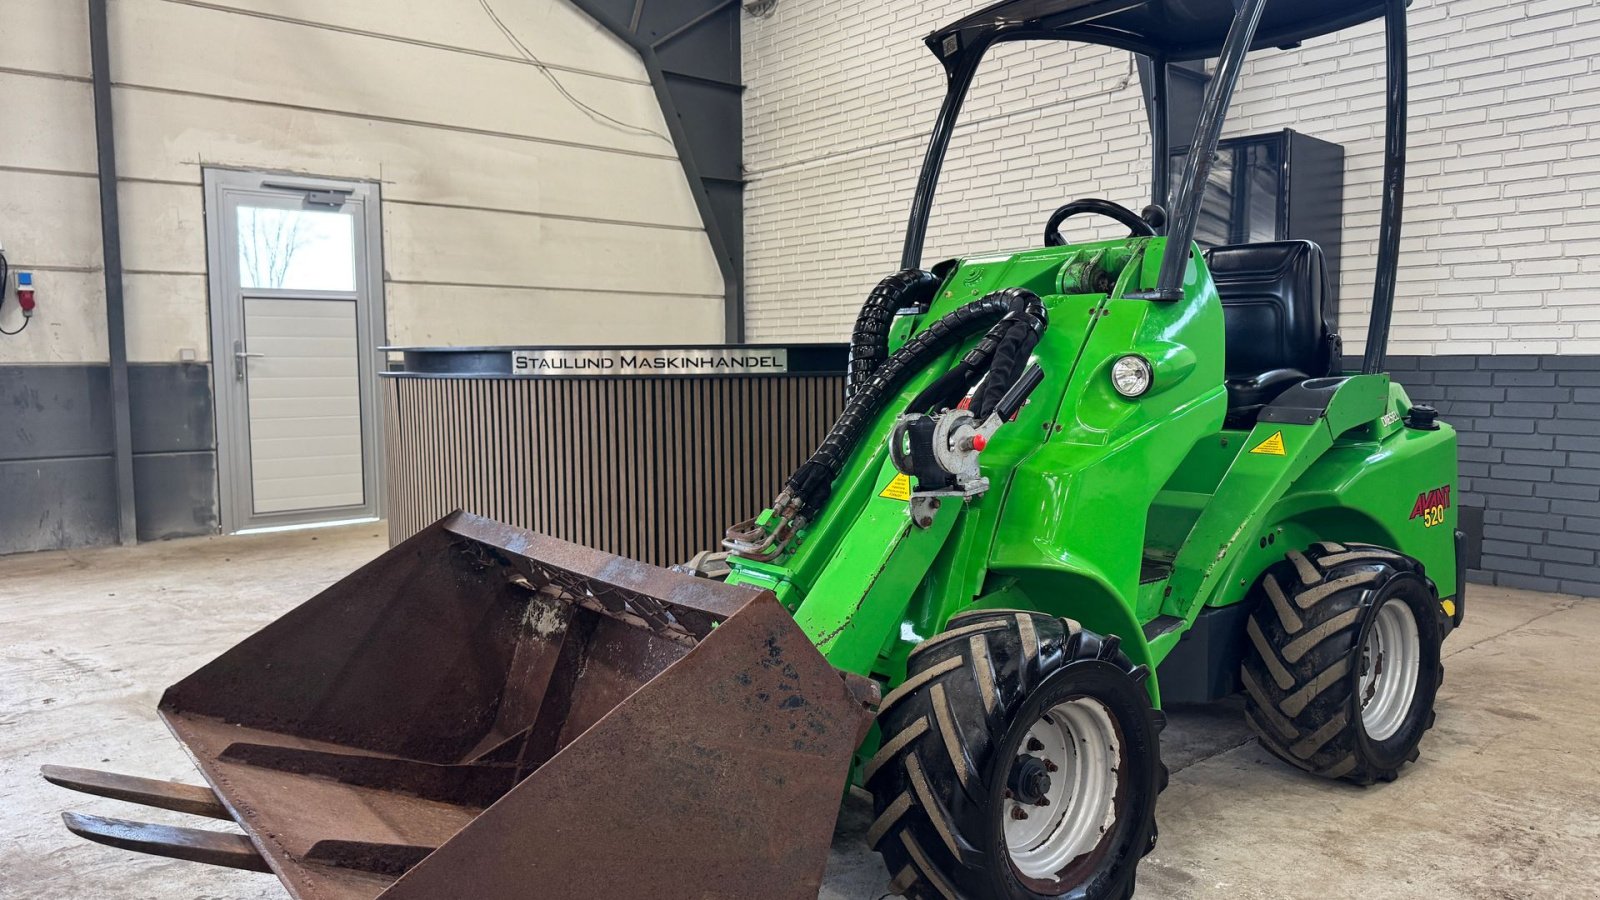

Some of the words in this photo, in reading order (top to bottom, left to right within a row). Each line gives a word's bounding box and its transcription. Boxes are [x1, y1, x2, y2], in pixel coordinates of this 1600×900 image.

[516, 356, 614, 369] STAULUND
[620, 355, 783, 369] MASKINHANDEL
[1409, 484, 1450, 520] AVANT
[1424, 504, 1444, 528] 520
